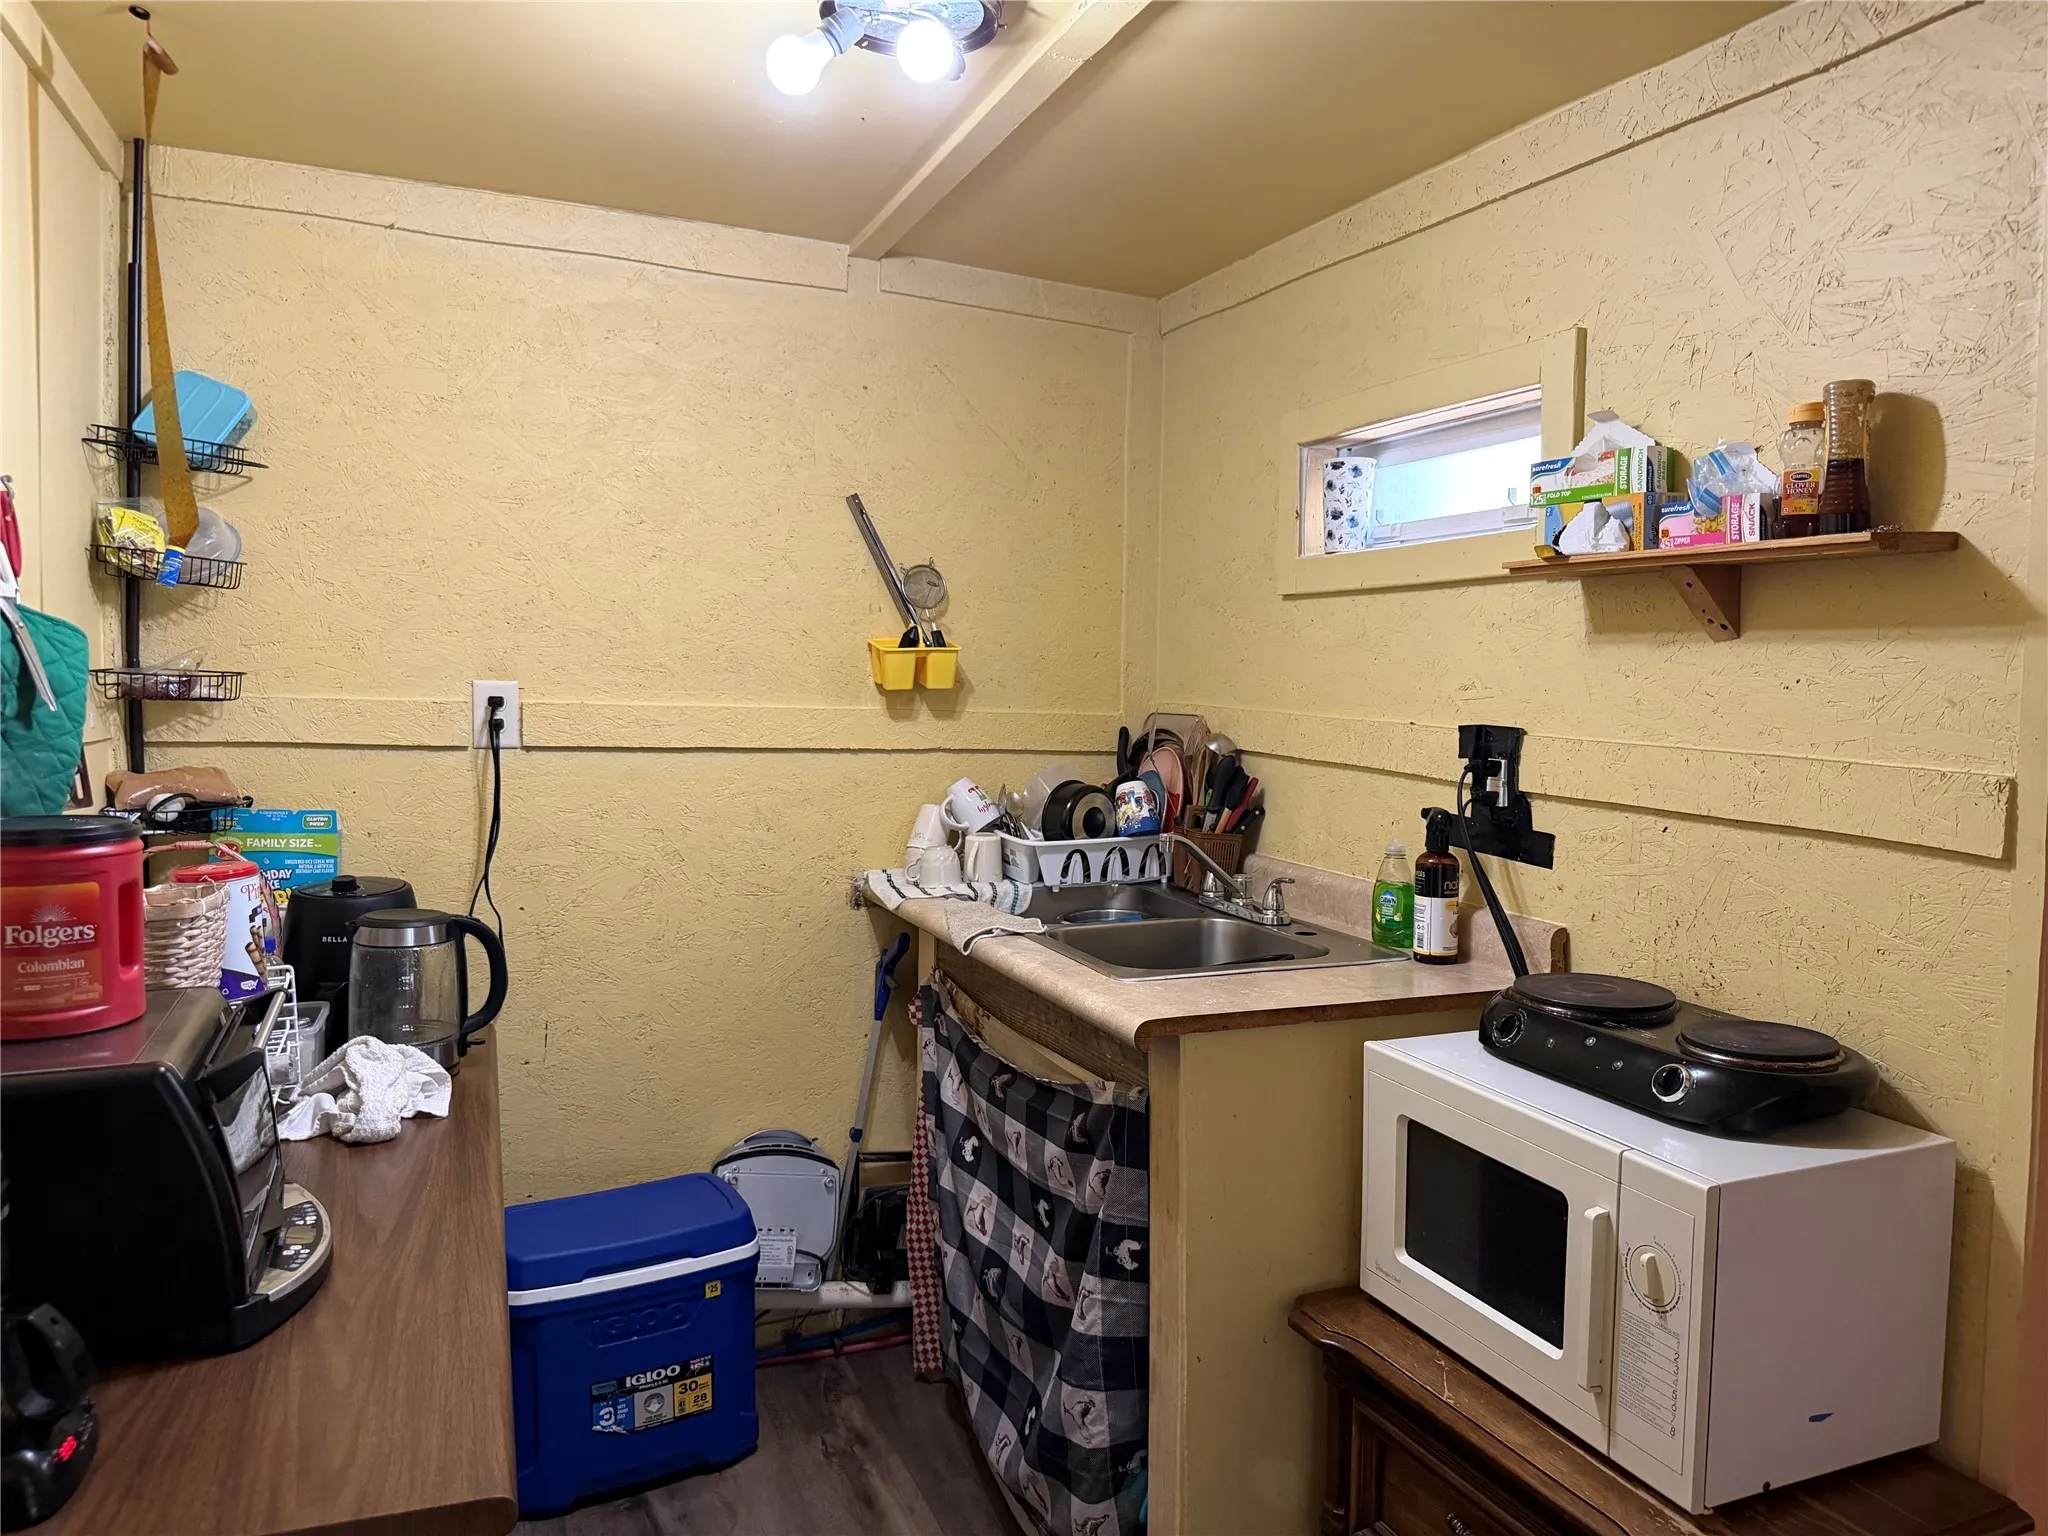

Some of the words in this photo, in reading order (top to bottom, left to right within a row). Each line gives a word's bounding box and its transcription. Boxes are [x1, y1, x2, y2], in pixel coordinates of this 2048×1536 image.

[1532, 461, 1562, 472] surefresh
[1620, 455, 1628, 490] STORAGE
[1547, 491, 1560, 499] FOLD
[1561, 490, 1572, 498] TOP
[1530, 496, 1544, 506] 125
[1661, 504, 1691, 514] surefresh
[1731, 502, 1740, 540] STORAGE
[1748, 503, 1756, 537] SNACK
[1660, 540, 1671, 549] 45
[1674, 537, 1691, 545] ZIPPER
[246, 838, 287, 848] FAMILY
[289, 838, 314, 848] SIZE
[1381, 896, 1397, 905] DAWN
[4, 924, 96, 949] Folgers
[17, 958, 85, 974] Colombian
[1673, 1352, 1680, 1361] 2
[1673, 1365, 1679, 1375] 3
[625, 1364, 681, 1388] IGLOO
[678, 1379, 699, 1395] 30
[693, 1393, 707, 1404] 28
[1671, 1389, 1678, 1400] 5
[1671, 1402, 1677, 1412] 6
[1669, 1426, 1676, 1437] 8
